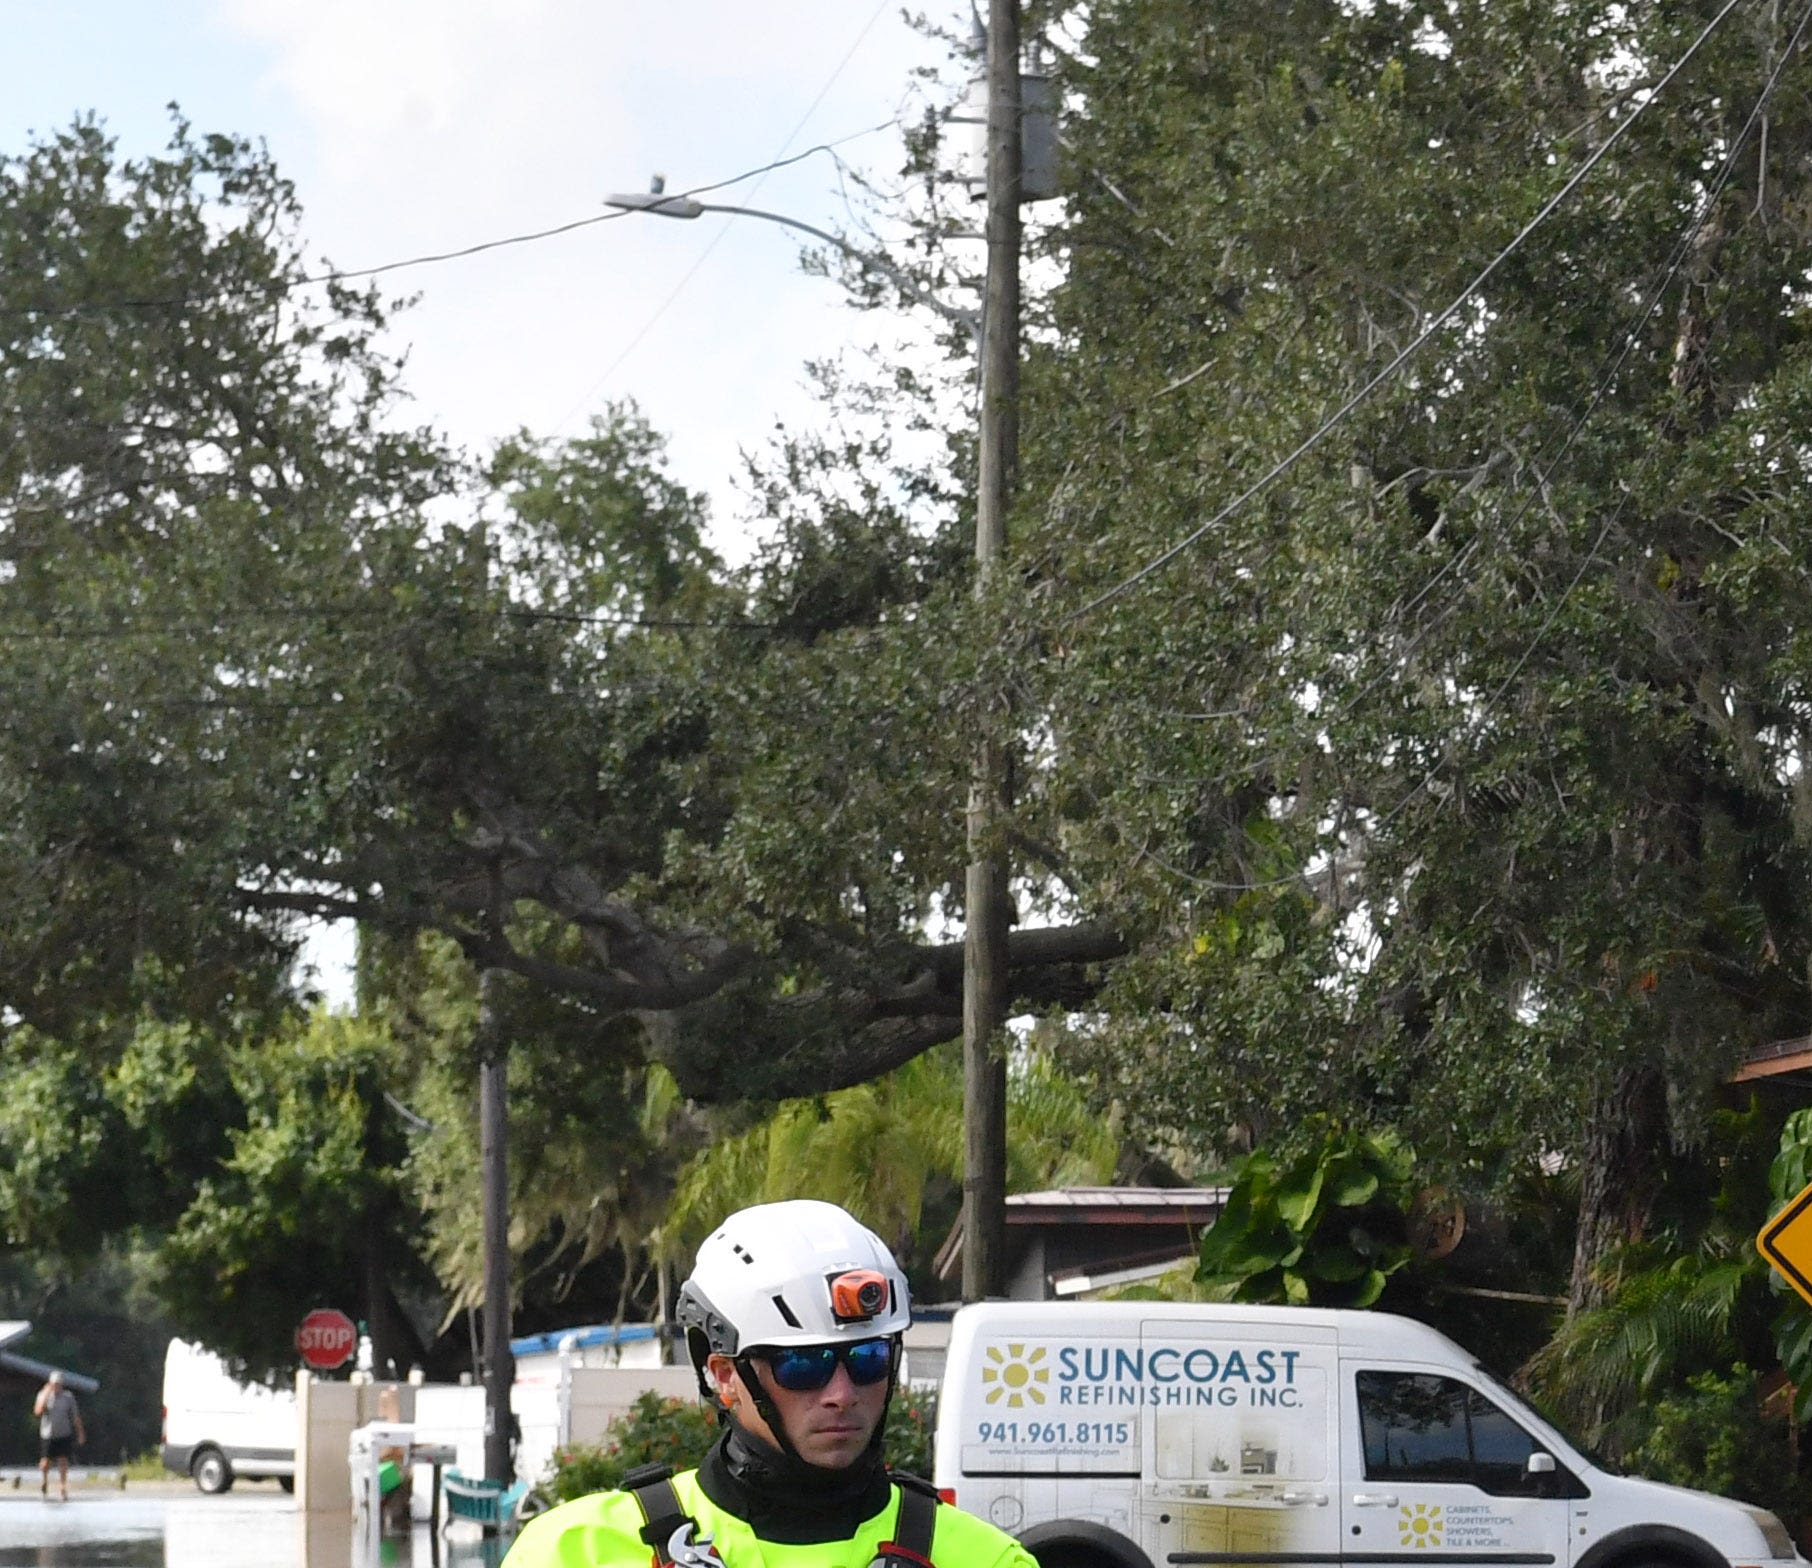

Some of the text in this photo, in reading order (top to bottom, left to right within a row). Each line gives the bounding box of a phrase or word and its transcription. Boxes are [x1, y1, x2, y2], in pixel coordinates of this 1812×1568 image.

[300, 1328, 351, 1350] STOP
[1058, 1347, 1300, 1384] SUNCOAST
[1060, 1385, 1303, 1408] REFINISHING INC.
[978, 1422, 1129, 1444] 941.961.8115
[1447, 1538, 1463, 1547] TILE
[1466, 1538, 1473, 1547] &
